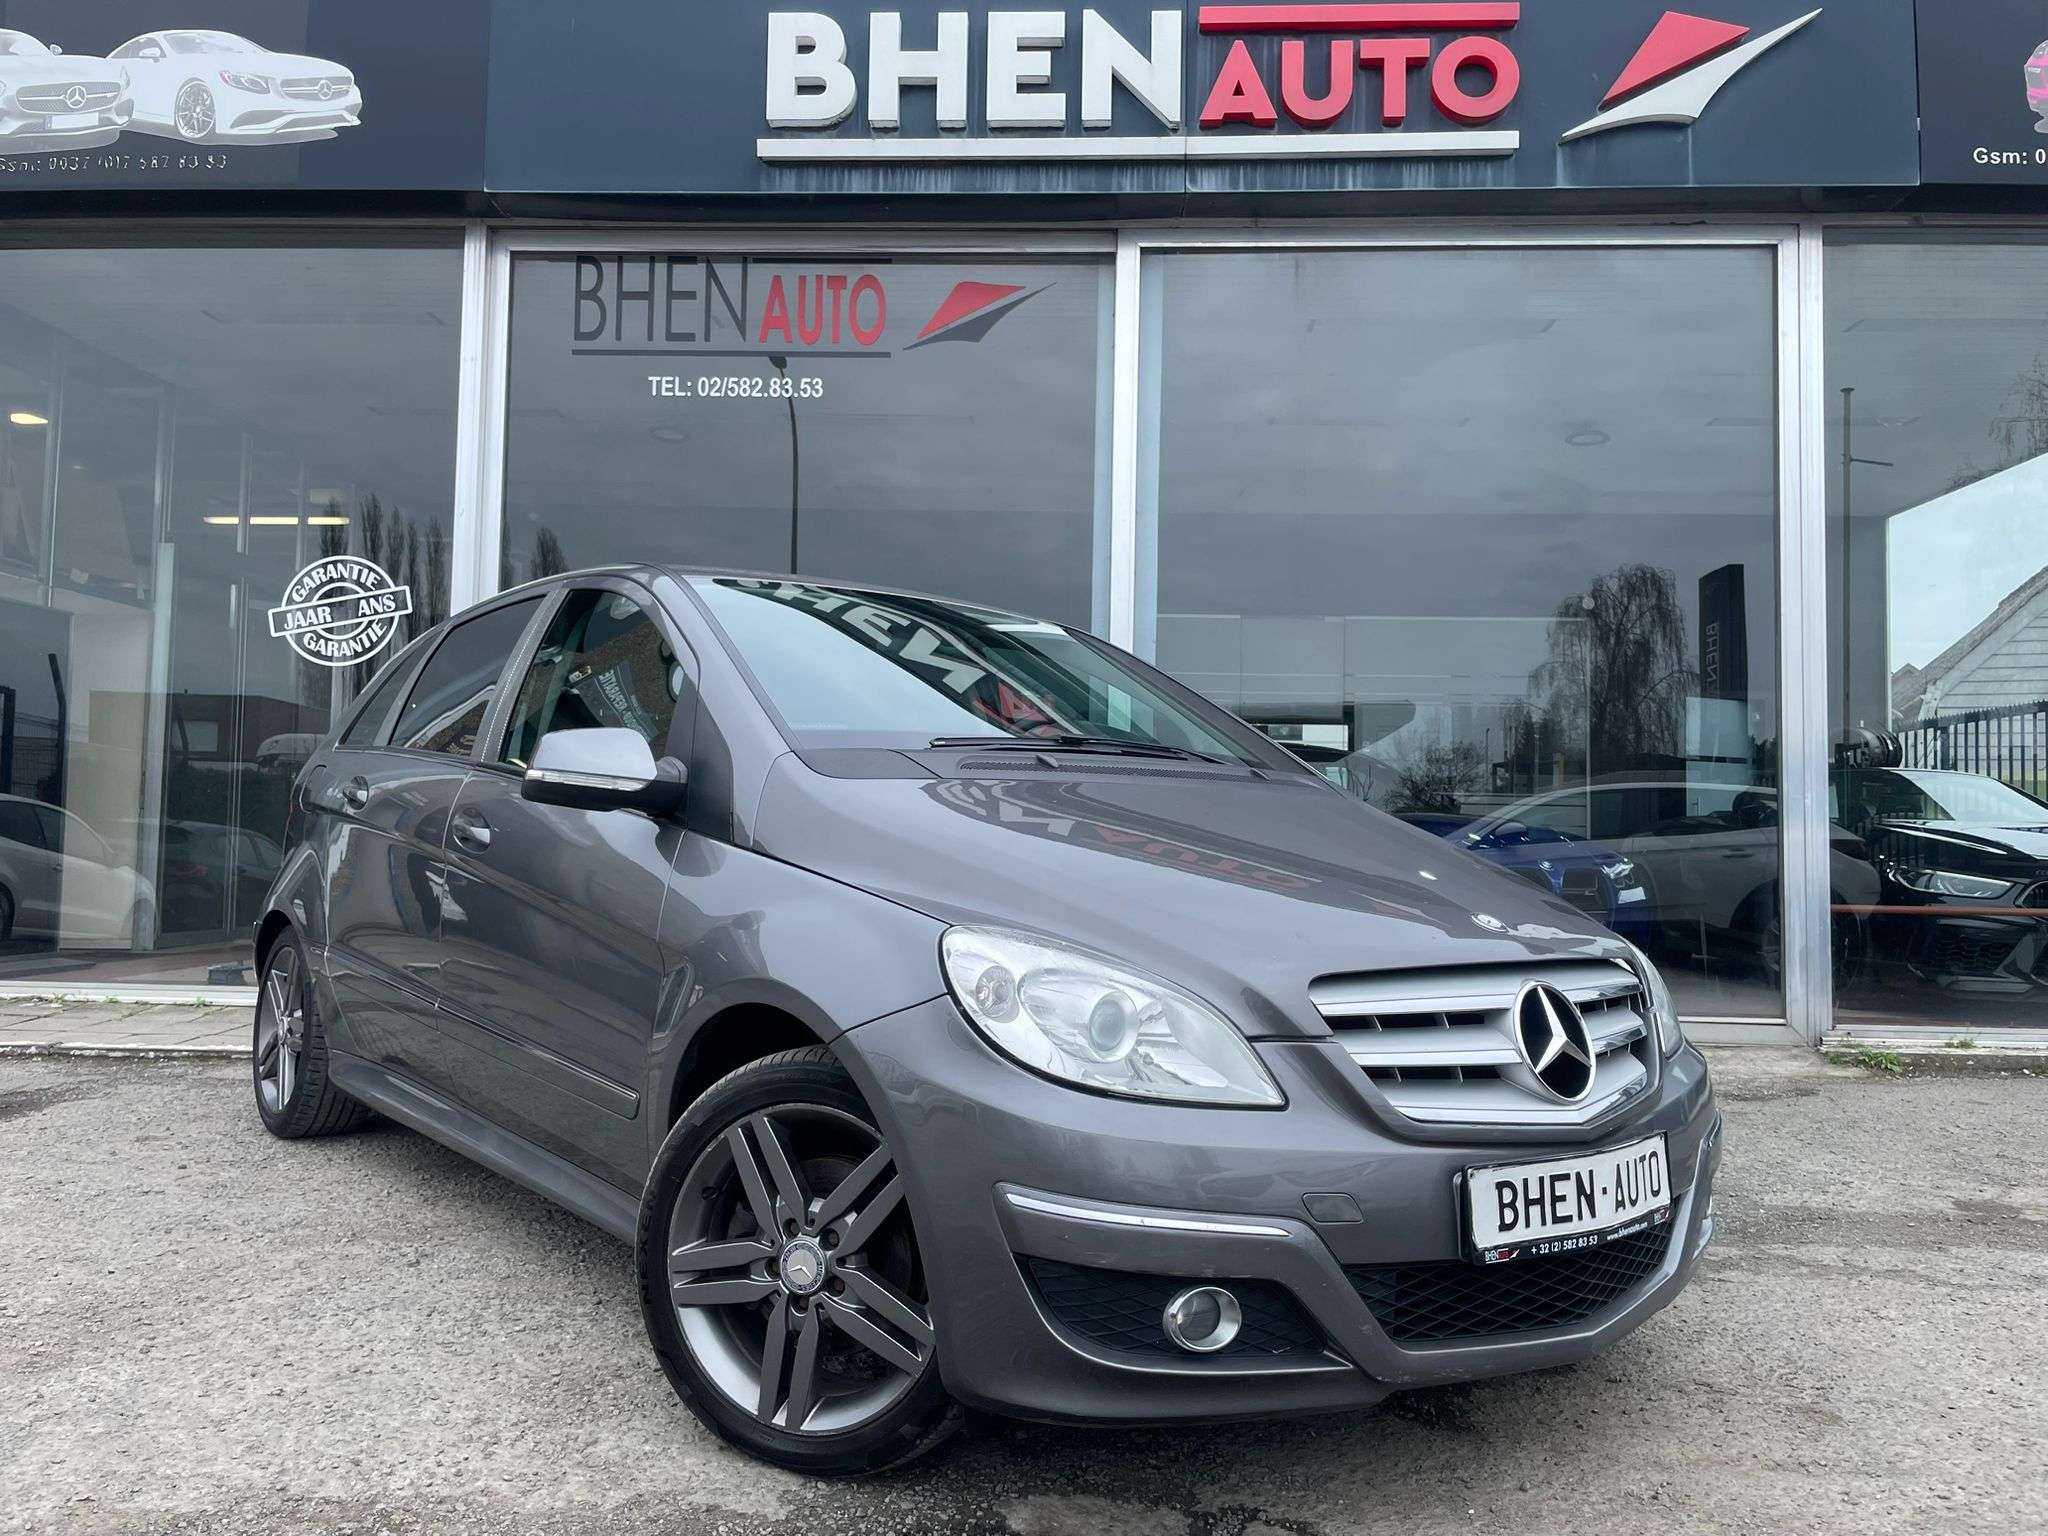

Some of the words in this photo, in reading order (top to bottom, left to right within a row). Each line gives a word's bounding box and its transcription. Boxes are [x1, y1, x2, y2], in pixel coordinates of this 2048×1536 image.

[766, 9, 1182, 129] BHEN
[1199, 36, 1521, 127] AUTO
[1973, 147, 2028, 165] Gsm:
[574, 255, 748, 342] BHEN
[758, 274, 887, 346] AUTO
[648, 376, 692, 397] TEL:
[697, 377, 824, 398] 02/582.83.53
[291, 563, 381, 602] GARANTIE
[284, 606, 332, 630] JAAR
[358, 594, 396, 617] ANS
[303, 621, 388, 657] GARANTIE
[1540, 1243, 1550, 1254] 32
[1563, 1240, 1577, 1250] 582
